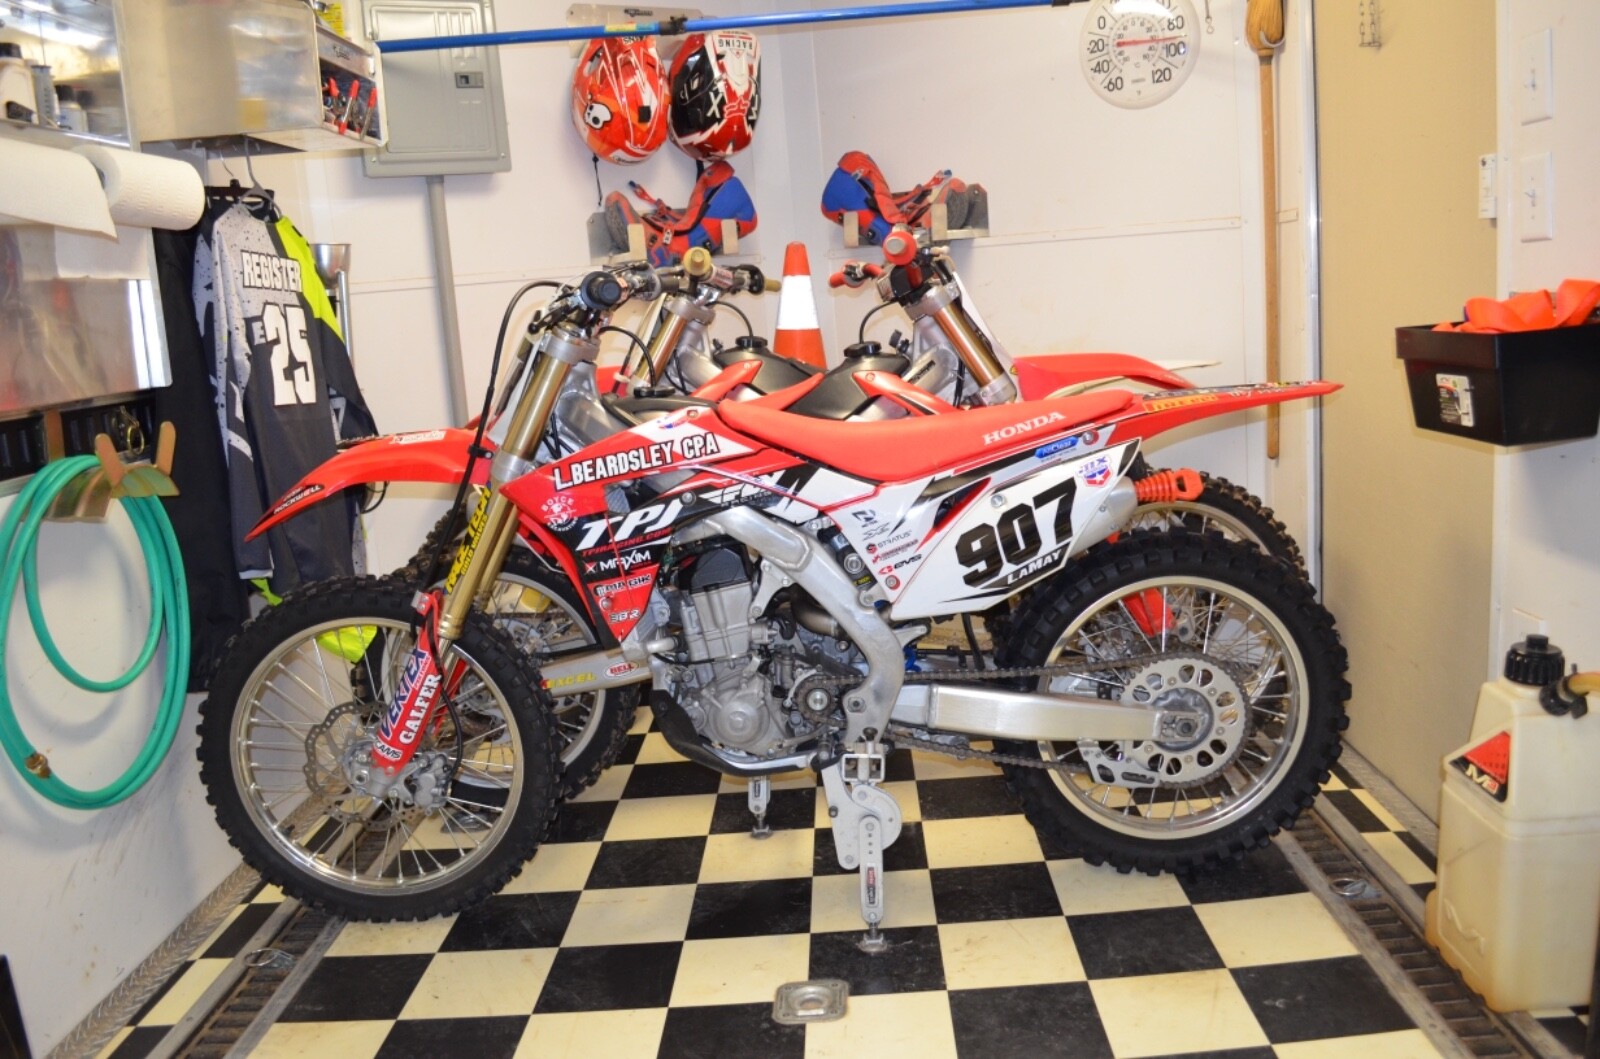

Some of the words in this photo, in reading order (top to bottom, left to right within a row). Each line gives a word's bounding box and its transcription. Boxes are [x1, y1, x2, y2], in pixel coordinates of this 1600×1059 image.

[1097, 15, 1106, 30] 0
[718, 39, 753, 50] RACING
[1087, 38, 1105, 54] -20
[1165, 41, 1186, 58] 100
[1090, 59, 1109, 74] -40
[1152, 67, 1172, 84] 120
[1103, 76, 1123, 92] -60
[241, 250, 303, 292] REGISTER
[263, 301, 317, 406] 25
[982, 411, 1066, 446] HONDA
[681, 432, 721, 464] CPA
[468, 487, 492, 538] TECH
[541, 496, 575, 512] BOYCE
[575, 497, 684, 551] TPJ
[955, 476, 1077, 588] 907
[877, 531, 912, 548] STRATUS
[1007, 549, 1062, 585] LAMAY
[608, 663, 635, 676] BELL
[380, 648, 428, 741] VERTEX
[399, 673, 442, 744] GALFER
